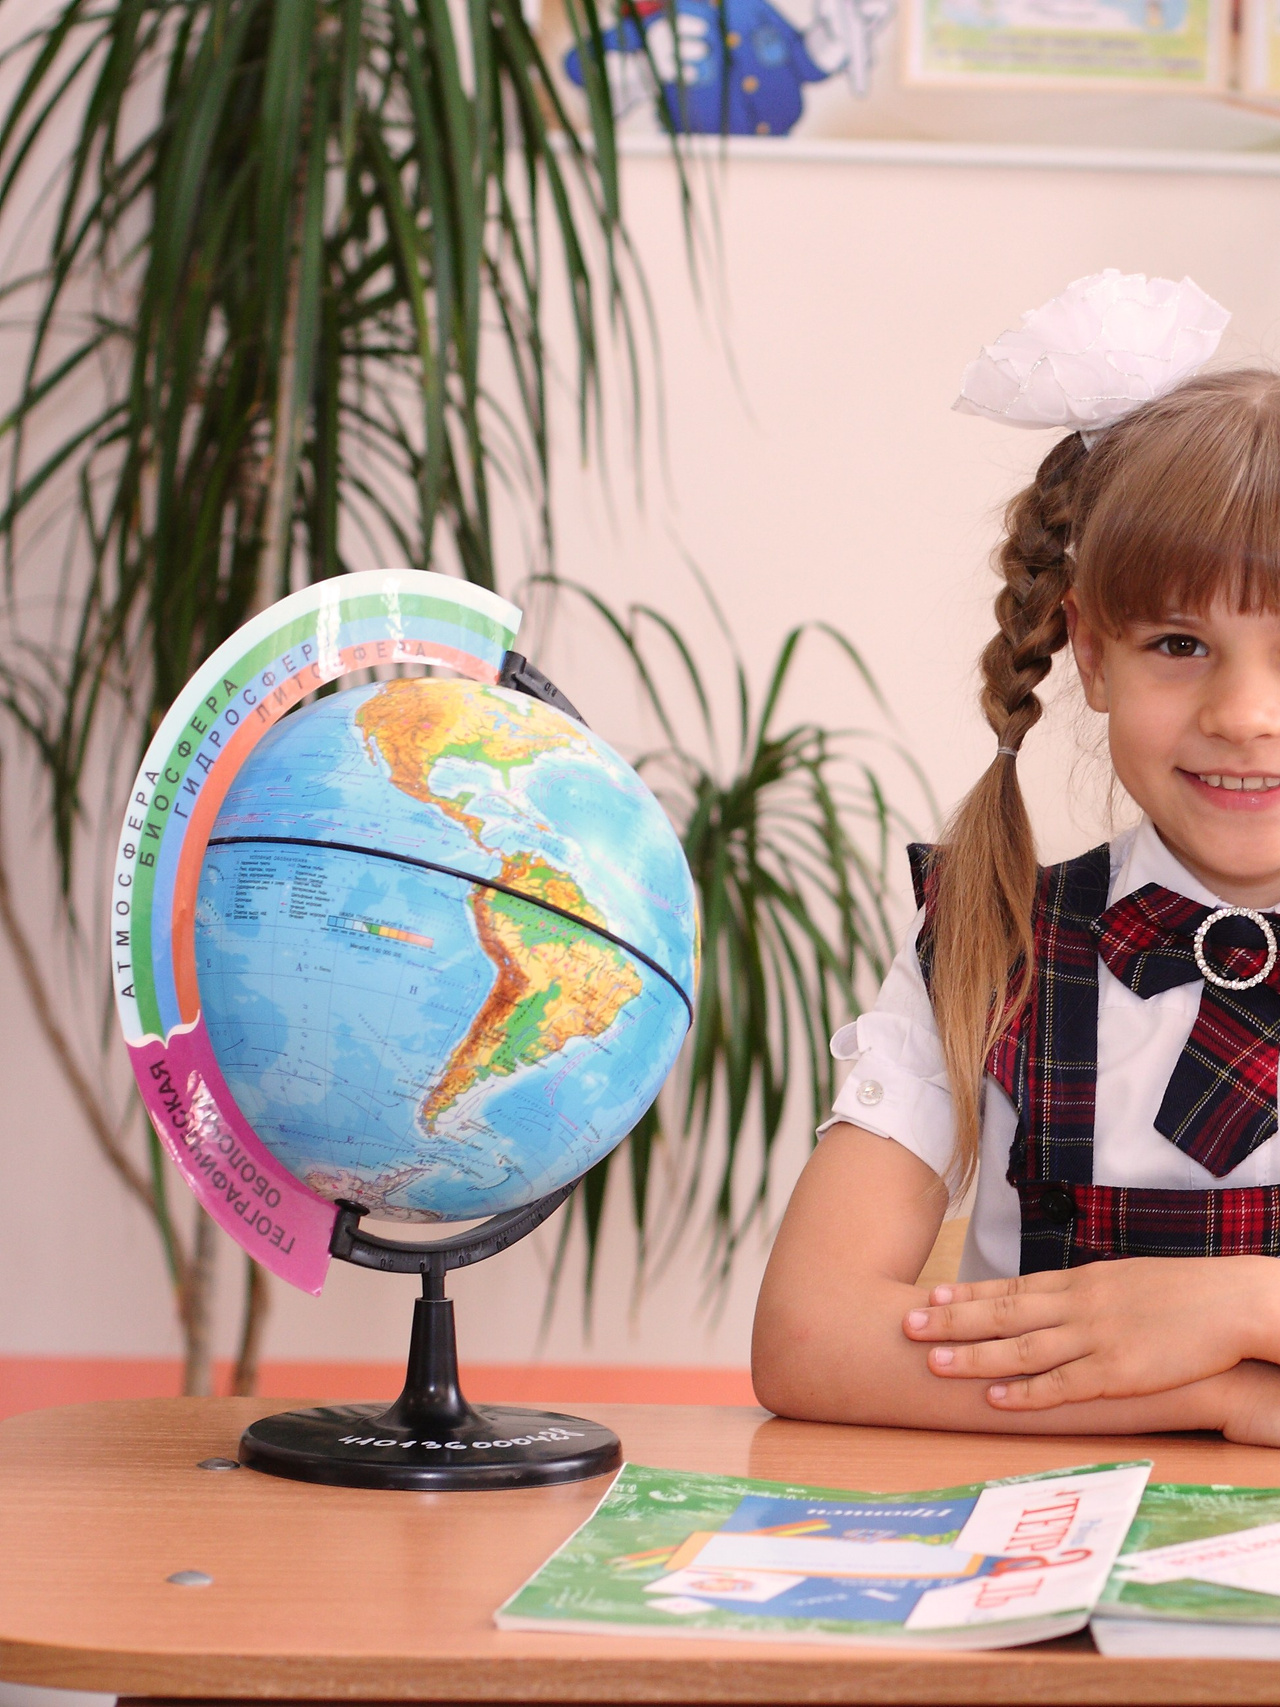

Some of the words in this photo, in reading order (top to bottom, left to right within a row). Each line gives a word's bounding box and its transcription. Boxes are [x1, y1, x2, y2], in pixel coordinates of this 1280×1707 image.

[139, 678, 238, 868] БИОСФЕРА
[174, 641, 318, 819] ГИДРОСФЕР
[115, 769, 160, 999] АТМОСФЕРА
[149, 1059, 296, 1254] ГЕОГРАФИЧЕСКАЯ
[199, 1100, 281, 1209] ОБОЛОЧ
